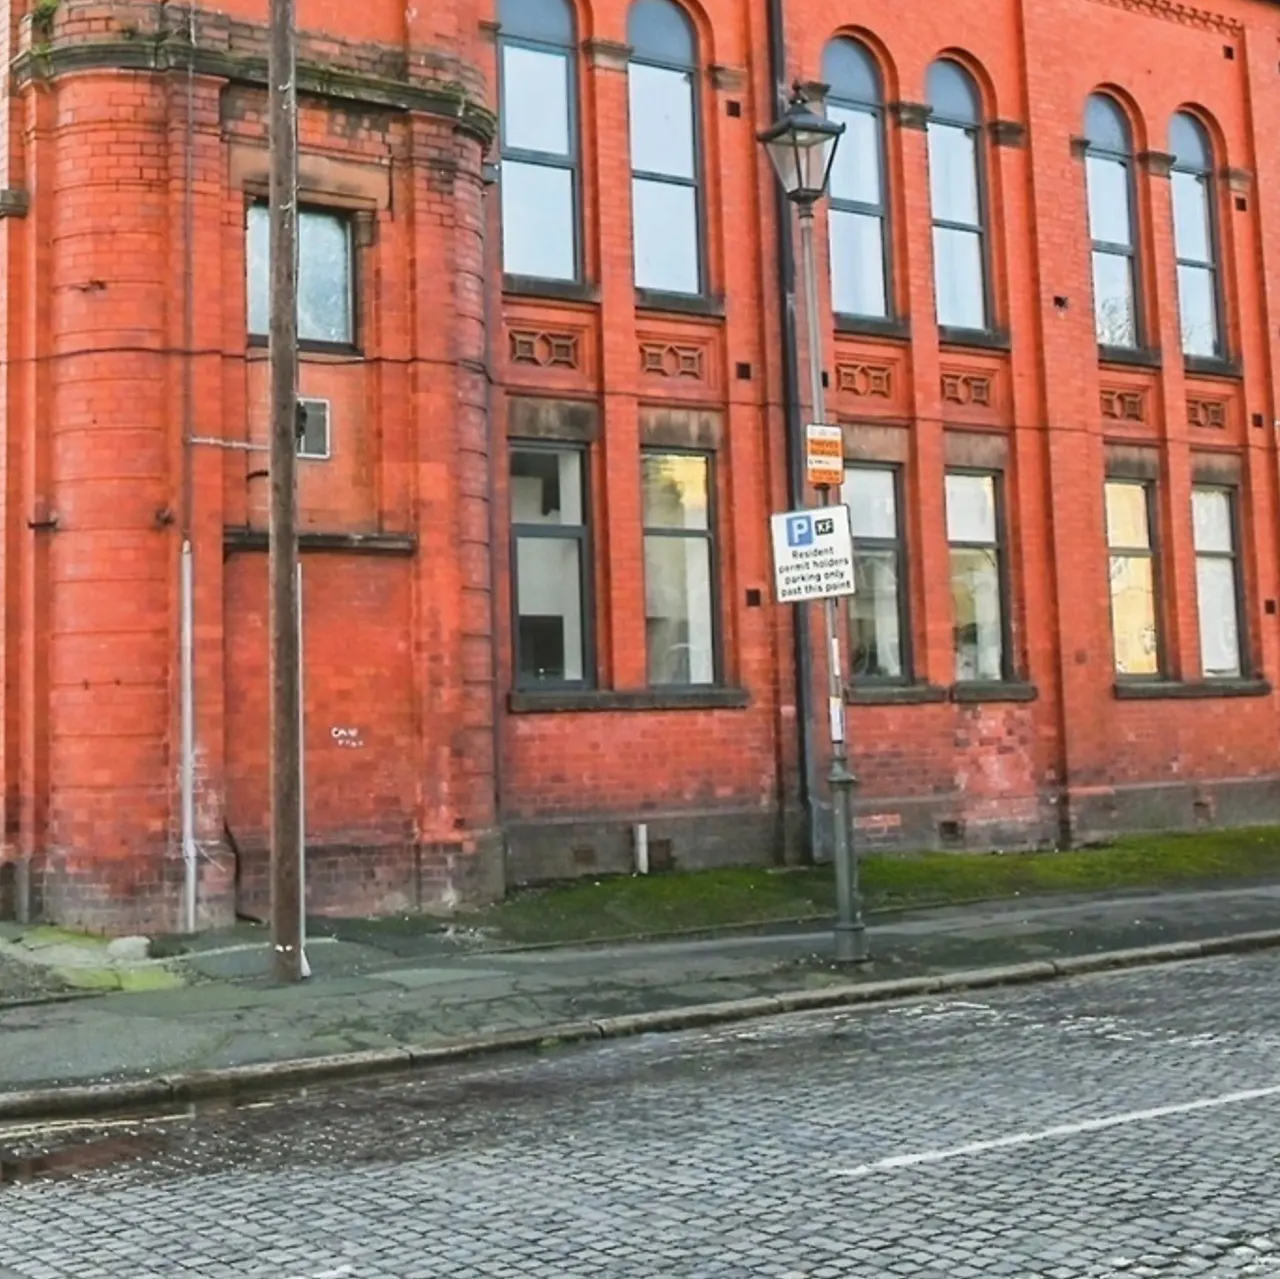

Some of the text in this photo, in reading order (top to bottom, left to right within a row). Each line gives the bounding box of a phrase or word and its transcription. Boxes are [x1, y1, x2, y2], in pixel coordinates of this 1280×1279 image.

[792, 519, 809, 544] P
[792, 547, 834, 559] Resident
[779, 558, 849, 574] permit holders
[784, 569, 844, 586] parking only
[781, 580, 851, 598] past this point
